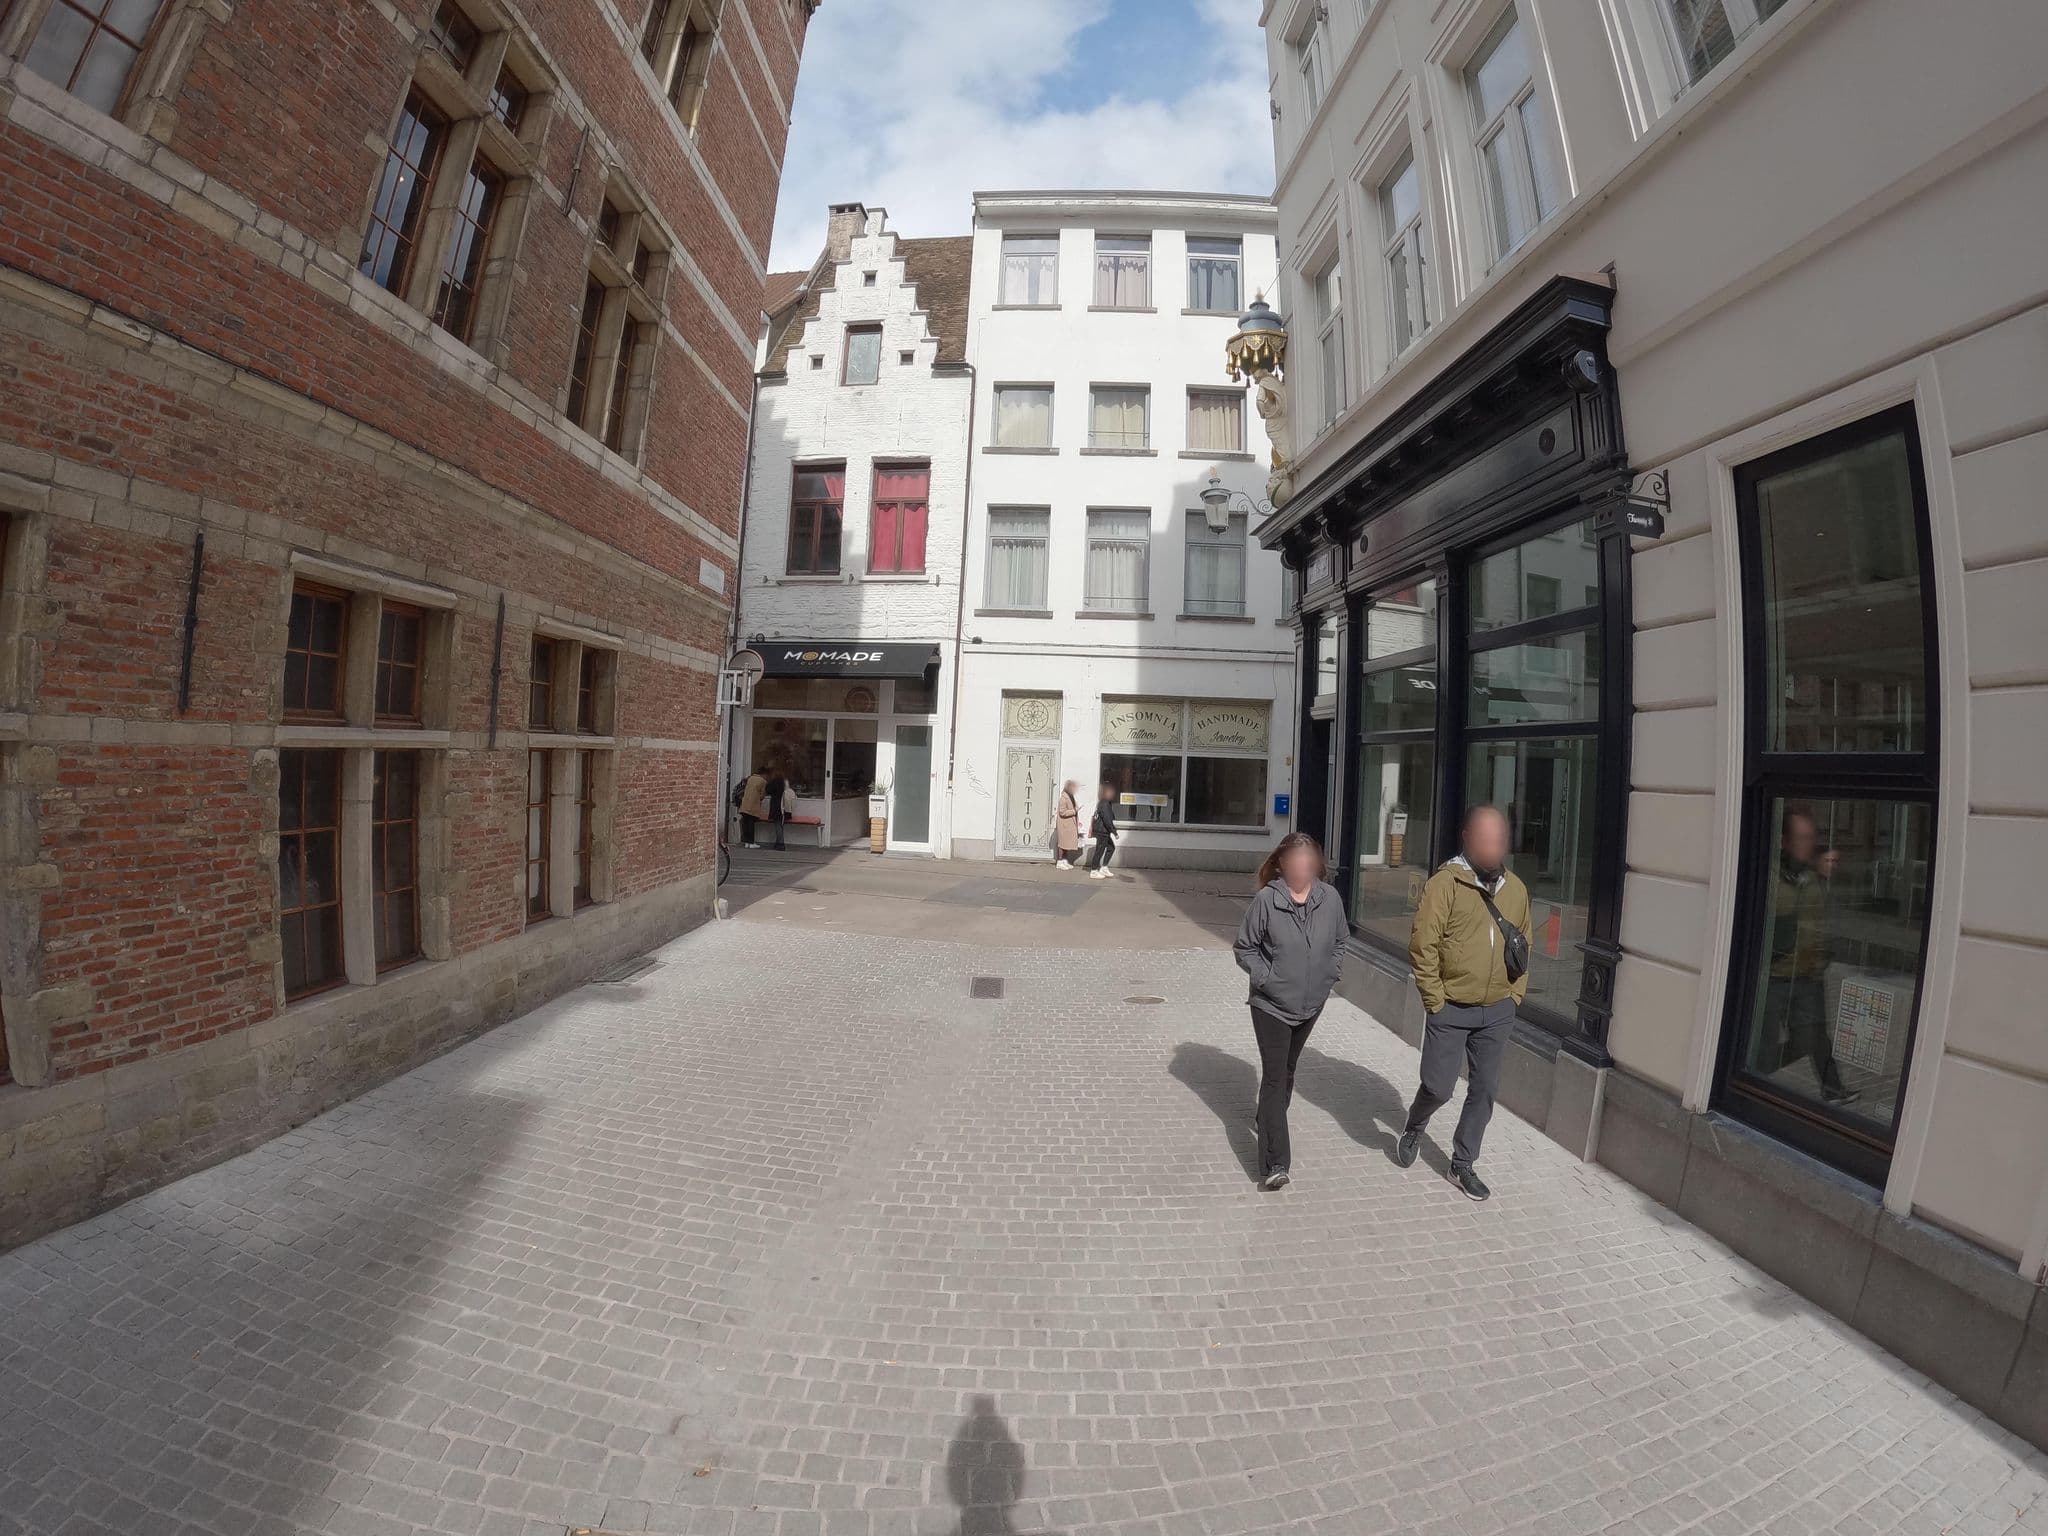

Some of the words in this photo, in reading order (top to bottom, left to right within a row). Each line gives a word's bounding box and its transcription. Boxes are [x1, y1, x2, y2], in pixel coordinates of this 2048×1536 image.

[783, 651, 885, 662] MOMADE
[1110, 711, 1177, 732] INSOMNIA
[1197, 713, 1262, 733] HANDMADE
[1126, 727, 1158, 740] Tattoos
[1210, 731, 1247, 745] Jewelry
[1022, 755, 1035, 846] TATTOO
